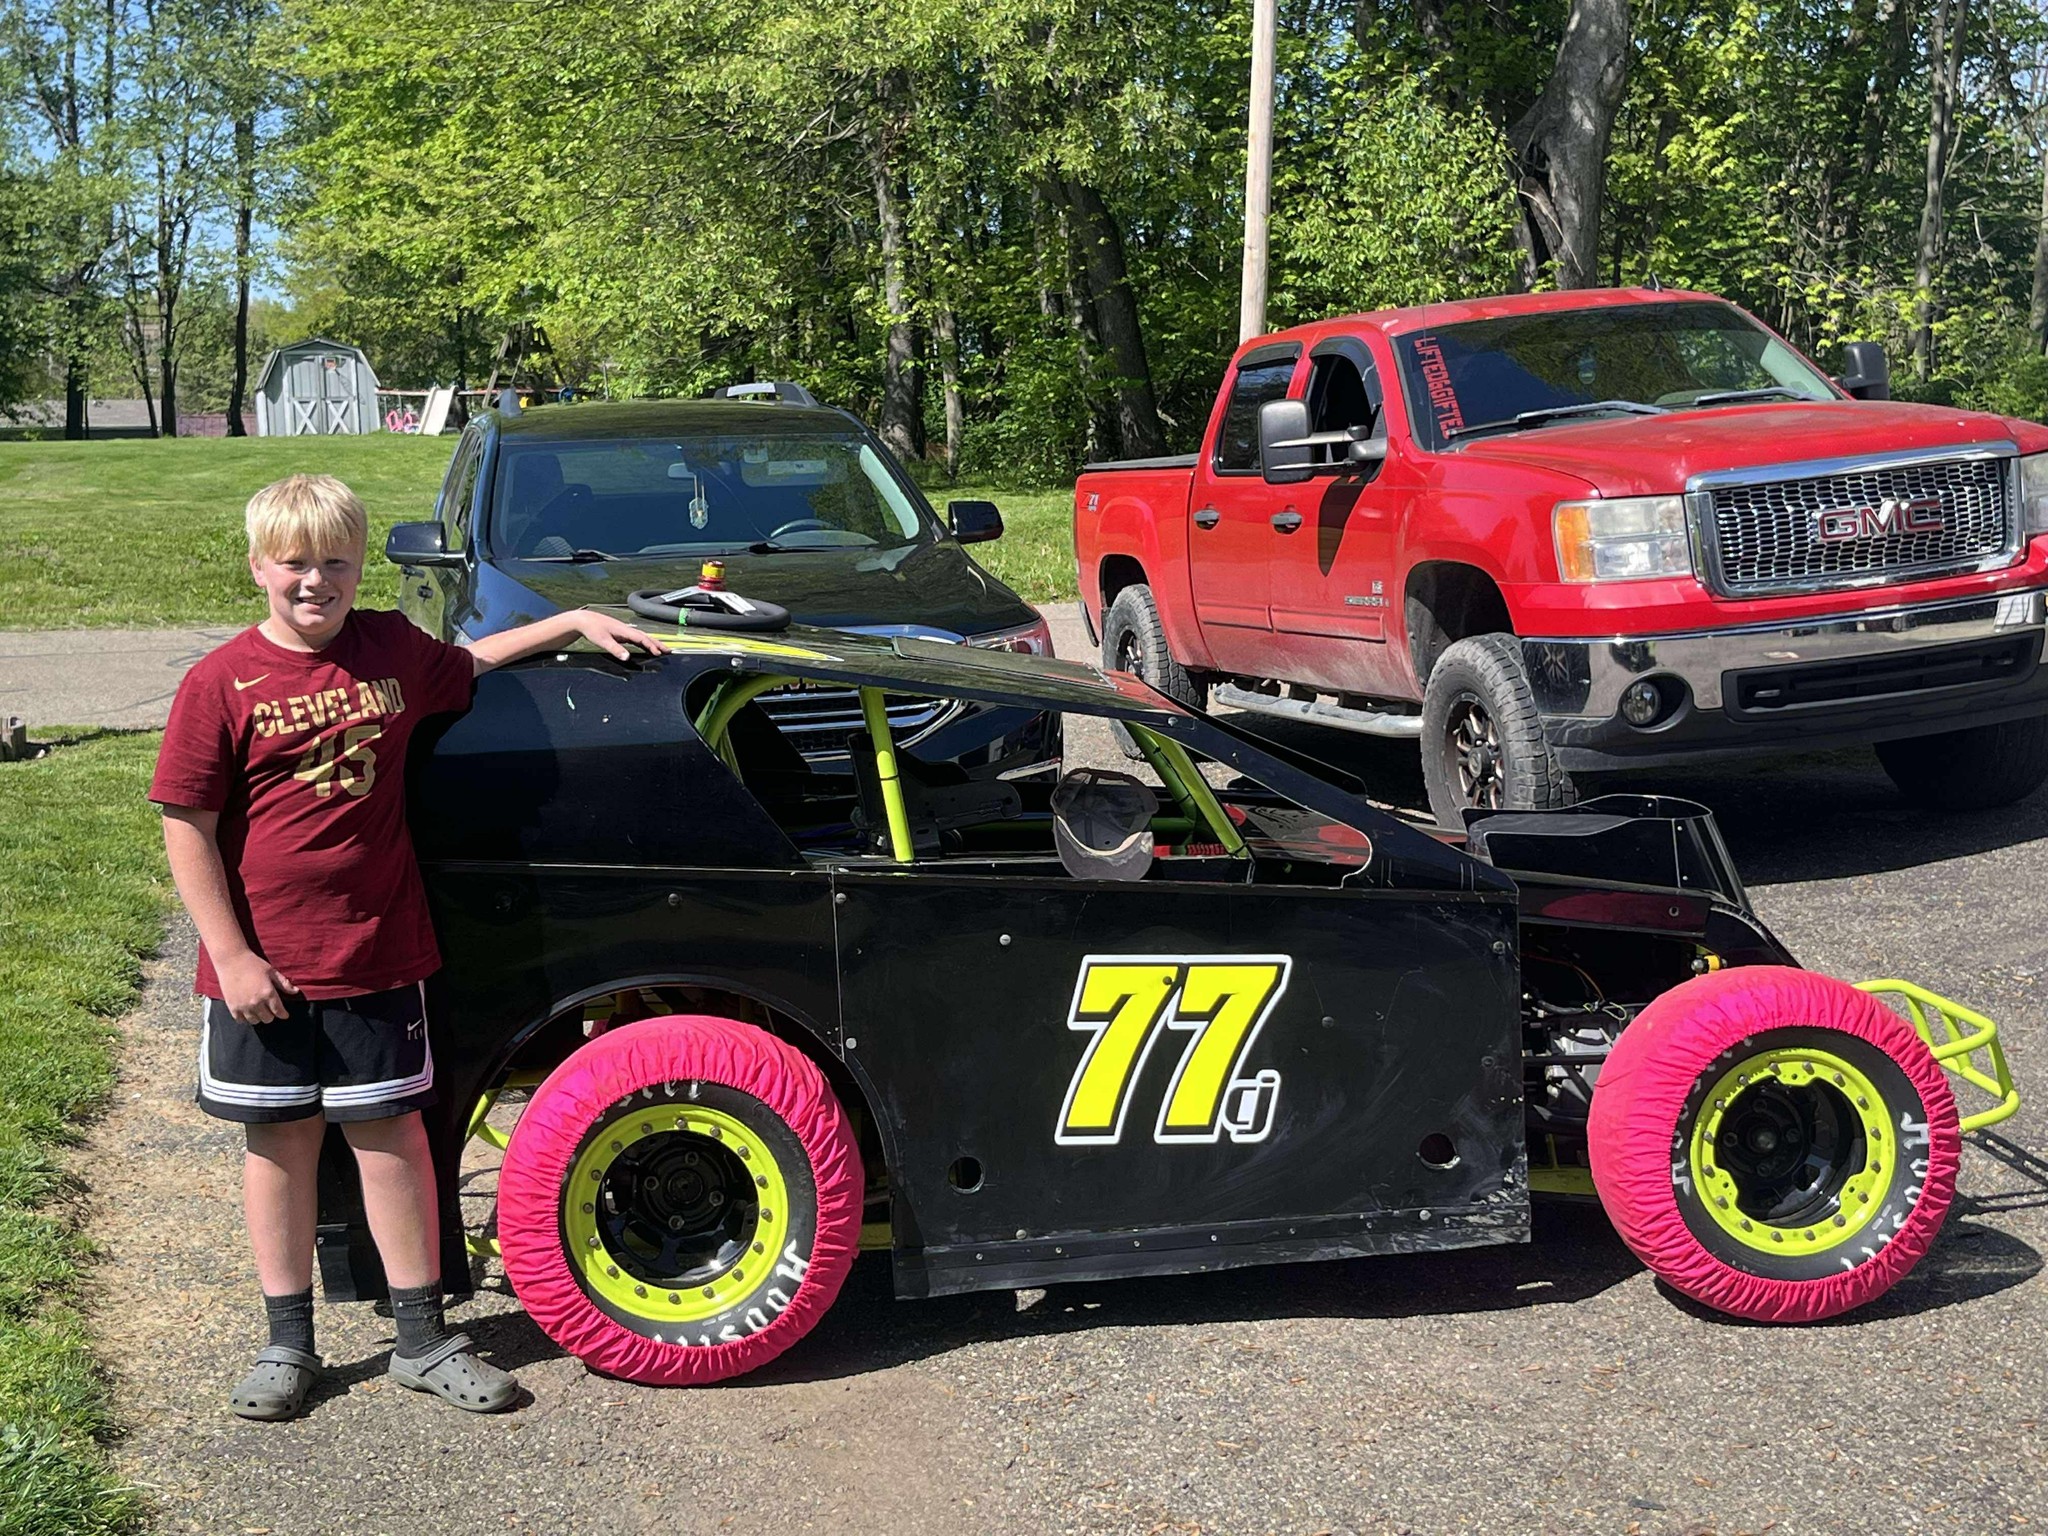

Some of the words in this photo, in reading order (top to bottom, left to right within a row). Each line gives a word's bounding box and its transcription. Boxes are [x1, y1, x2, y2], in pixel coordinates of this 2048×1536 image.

[1818, 499, 1945, 543] GMC
[253, 678, 406, 738] CLEVELAND
[294, 725, 377, 797] 45
